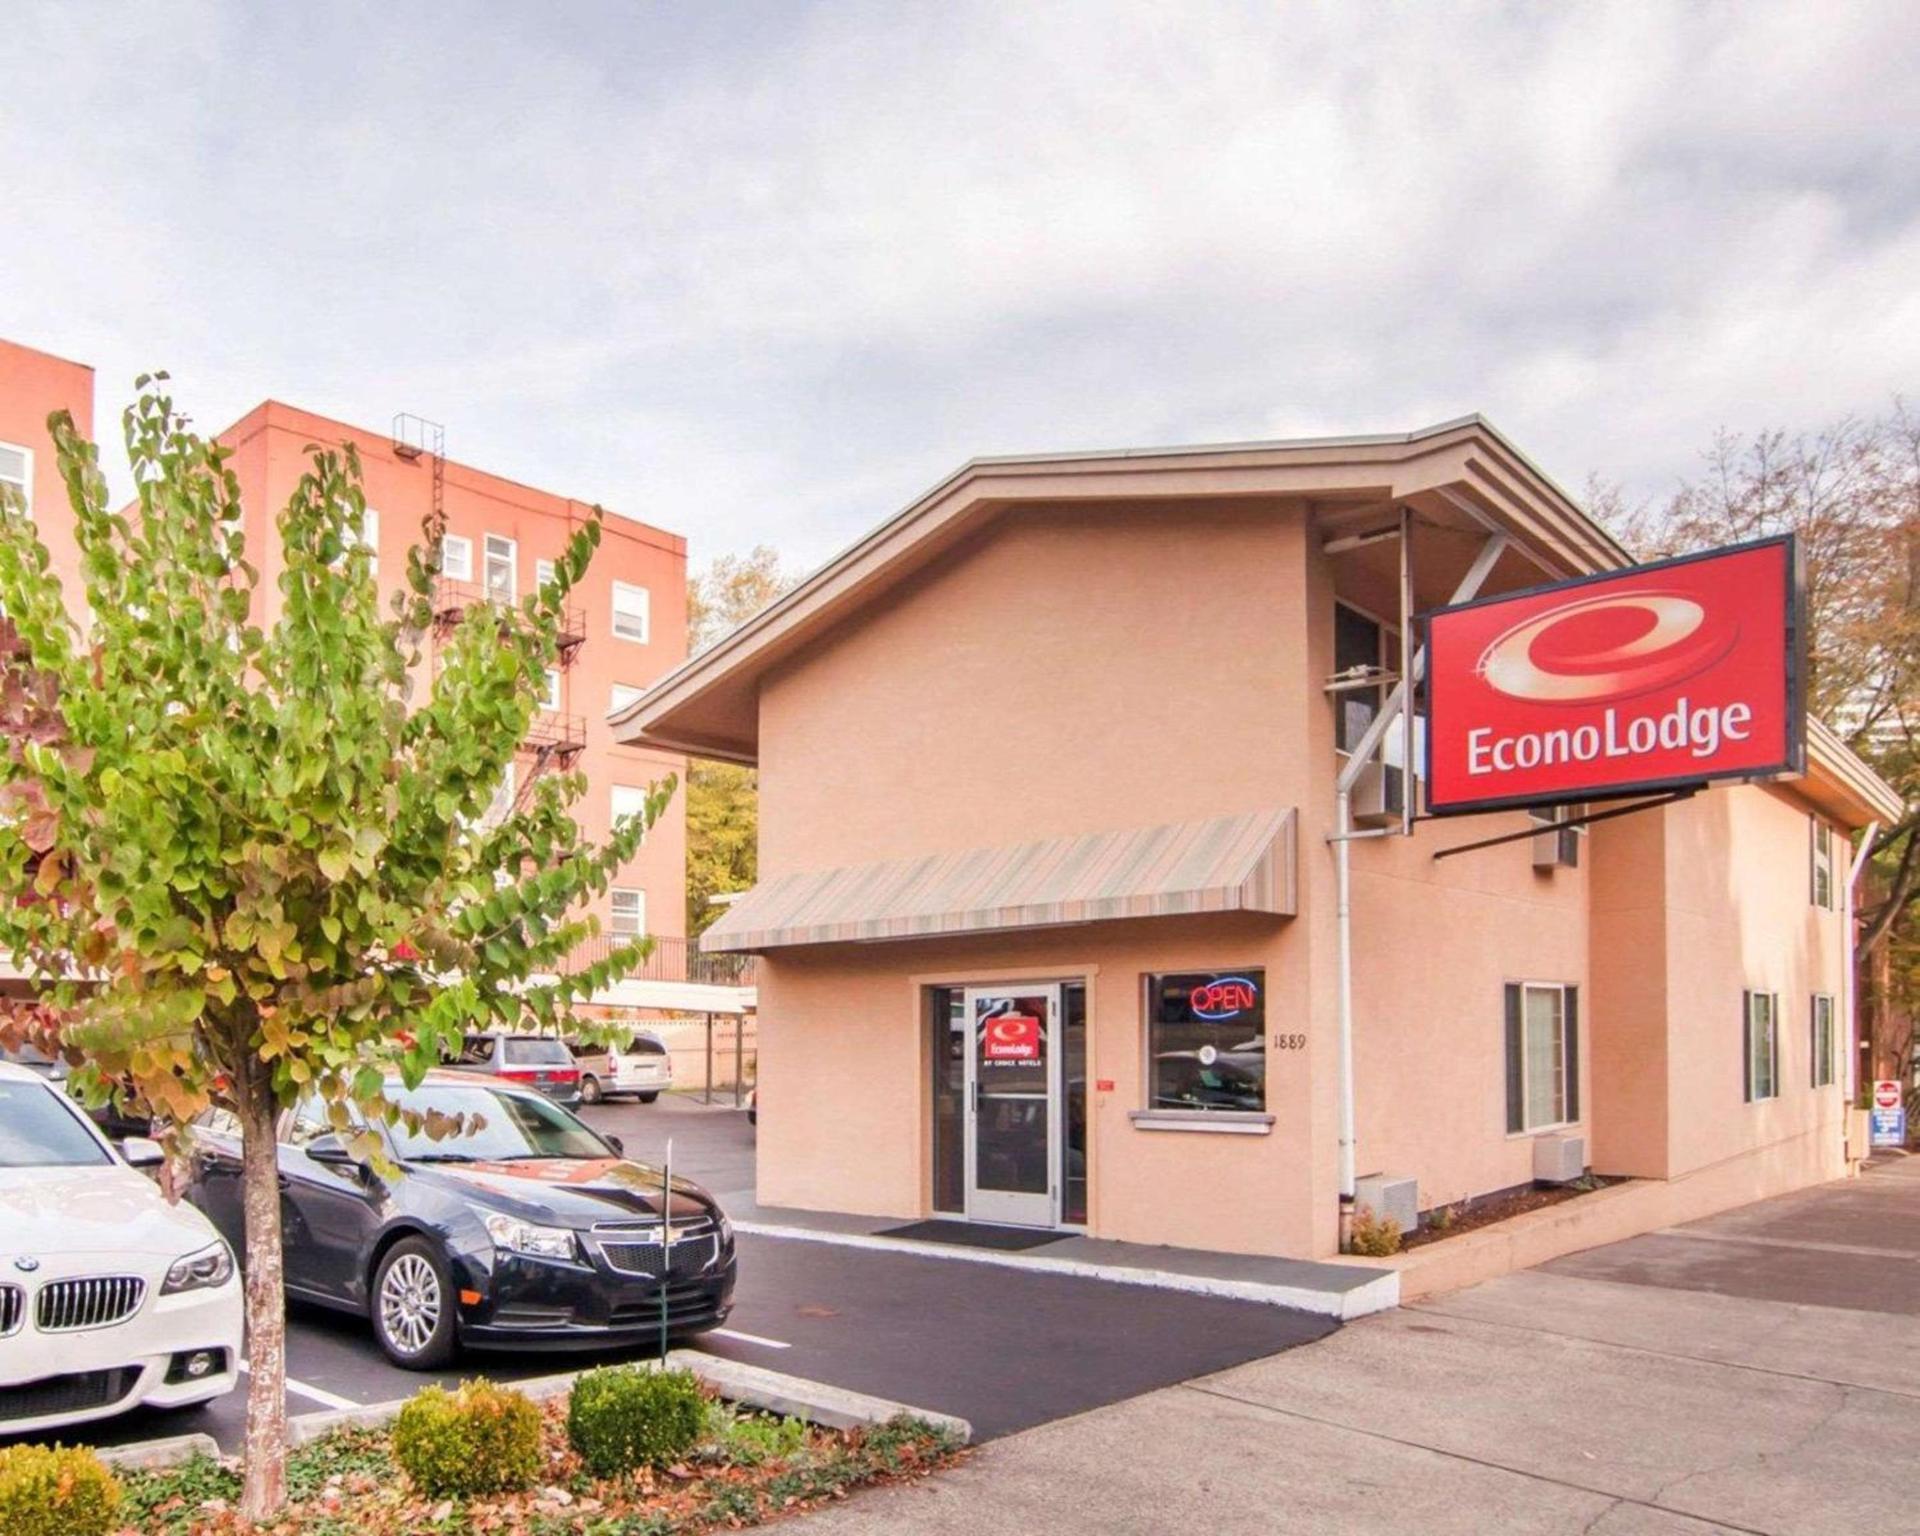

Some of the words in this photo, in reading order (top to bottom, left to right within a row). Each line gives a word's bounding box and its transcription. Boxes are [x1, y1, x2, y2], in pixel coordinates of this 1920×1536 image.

[1467, 697, 1752, 776] EconoLodge
[1191, 985, 1254, 1010] OPEN
[1274, 1034, 1306, 1049] 1889
